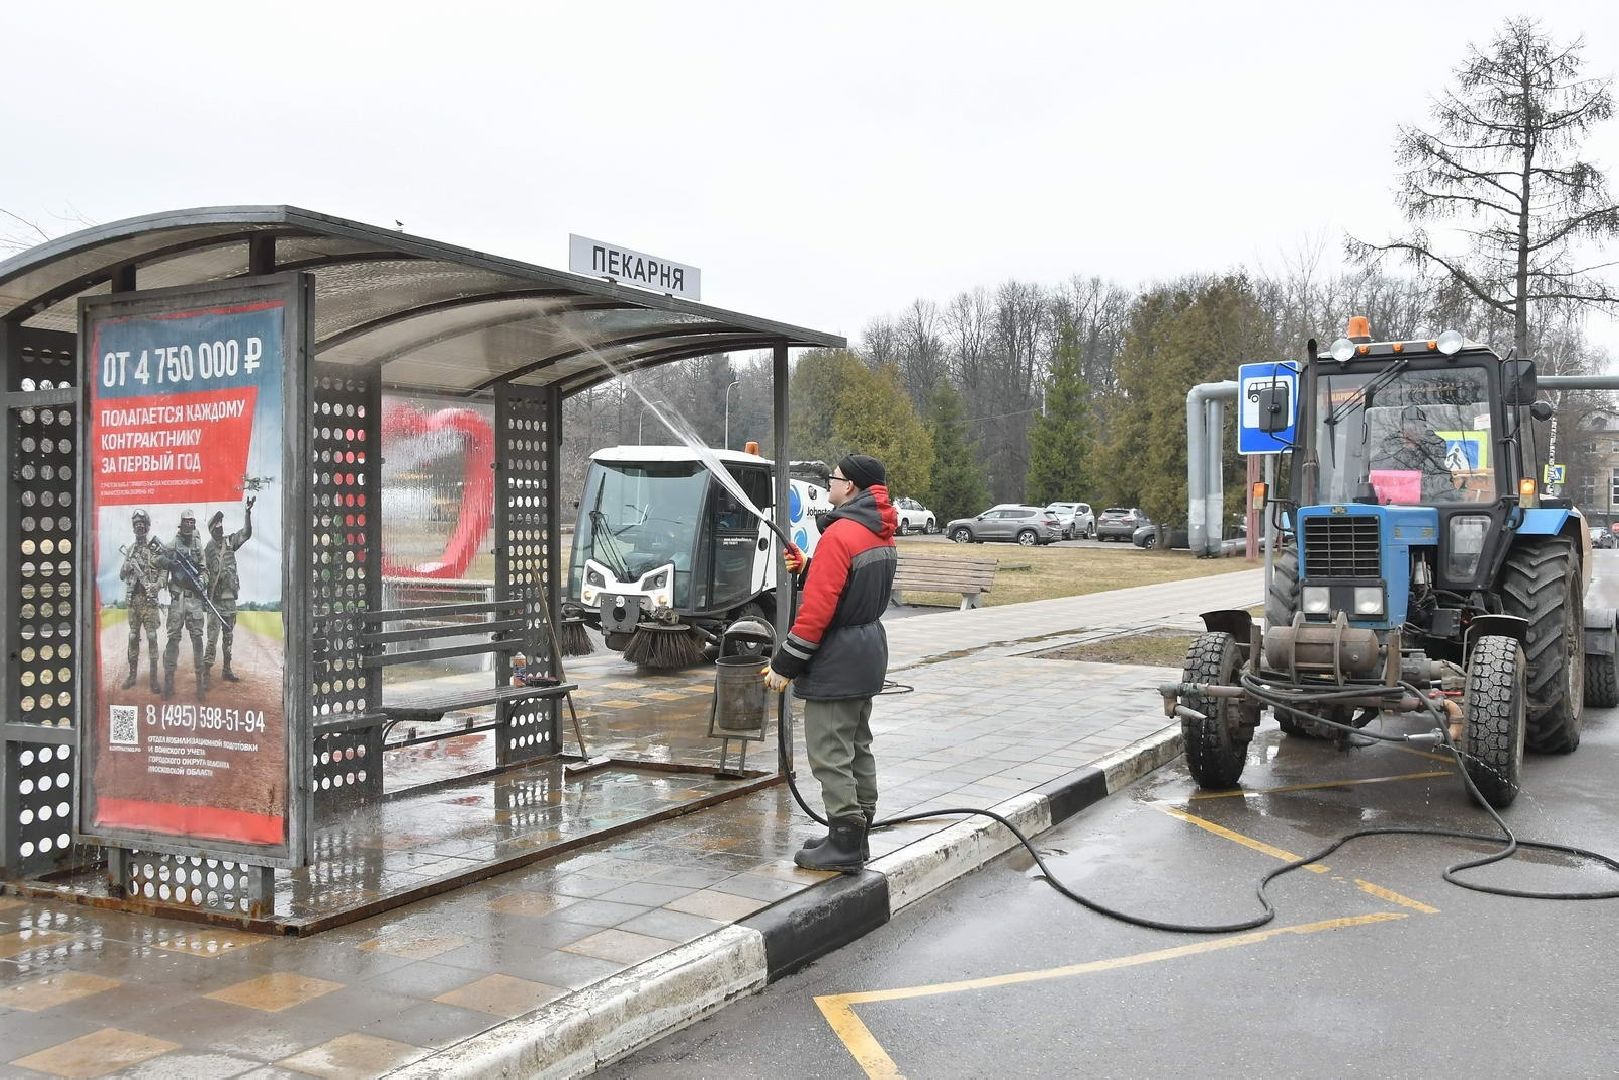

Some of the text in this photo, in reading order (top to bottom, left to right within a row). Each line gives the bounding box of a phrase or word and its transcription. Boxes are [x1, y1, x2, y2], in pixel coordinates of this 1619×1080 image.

[592, 245, 684, 291] ПЕКАРНЯ
[103, 351, 131, 388] ОТ
[134, 350, 150, 385] 4
[155, 344, 194, 384] 750
[198, 339, 239, 379] 000
[101, 399, 246, 427] ПОЛАГАЕТСЯ КАЖДОМУ
[101, 429, 202, 451] КОНТРАКТНИКУ
[101, 451, 201, 474] ЗА ПЕРВЫЙ ГОД
[146, 704, 266, 733] 8 (495) 598-51-94
[182, 758, 207, 767] ОКРУГА
